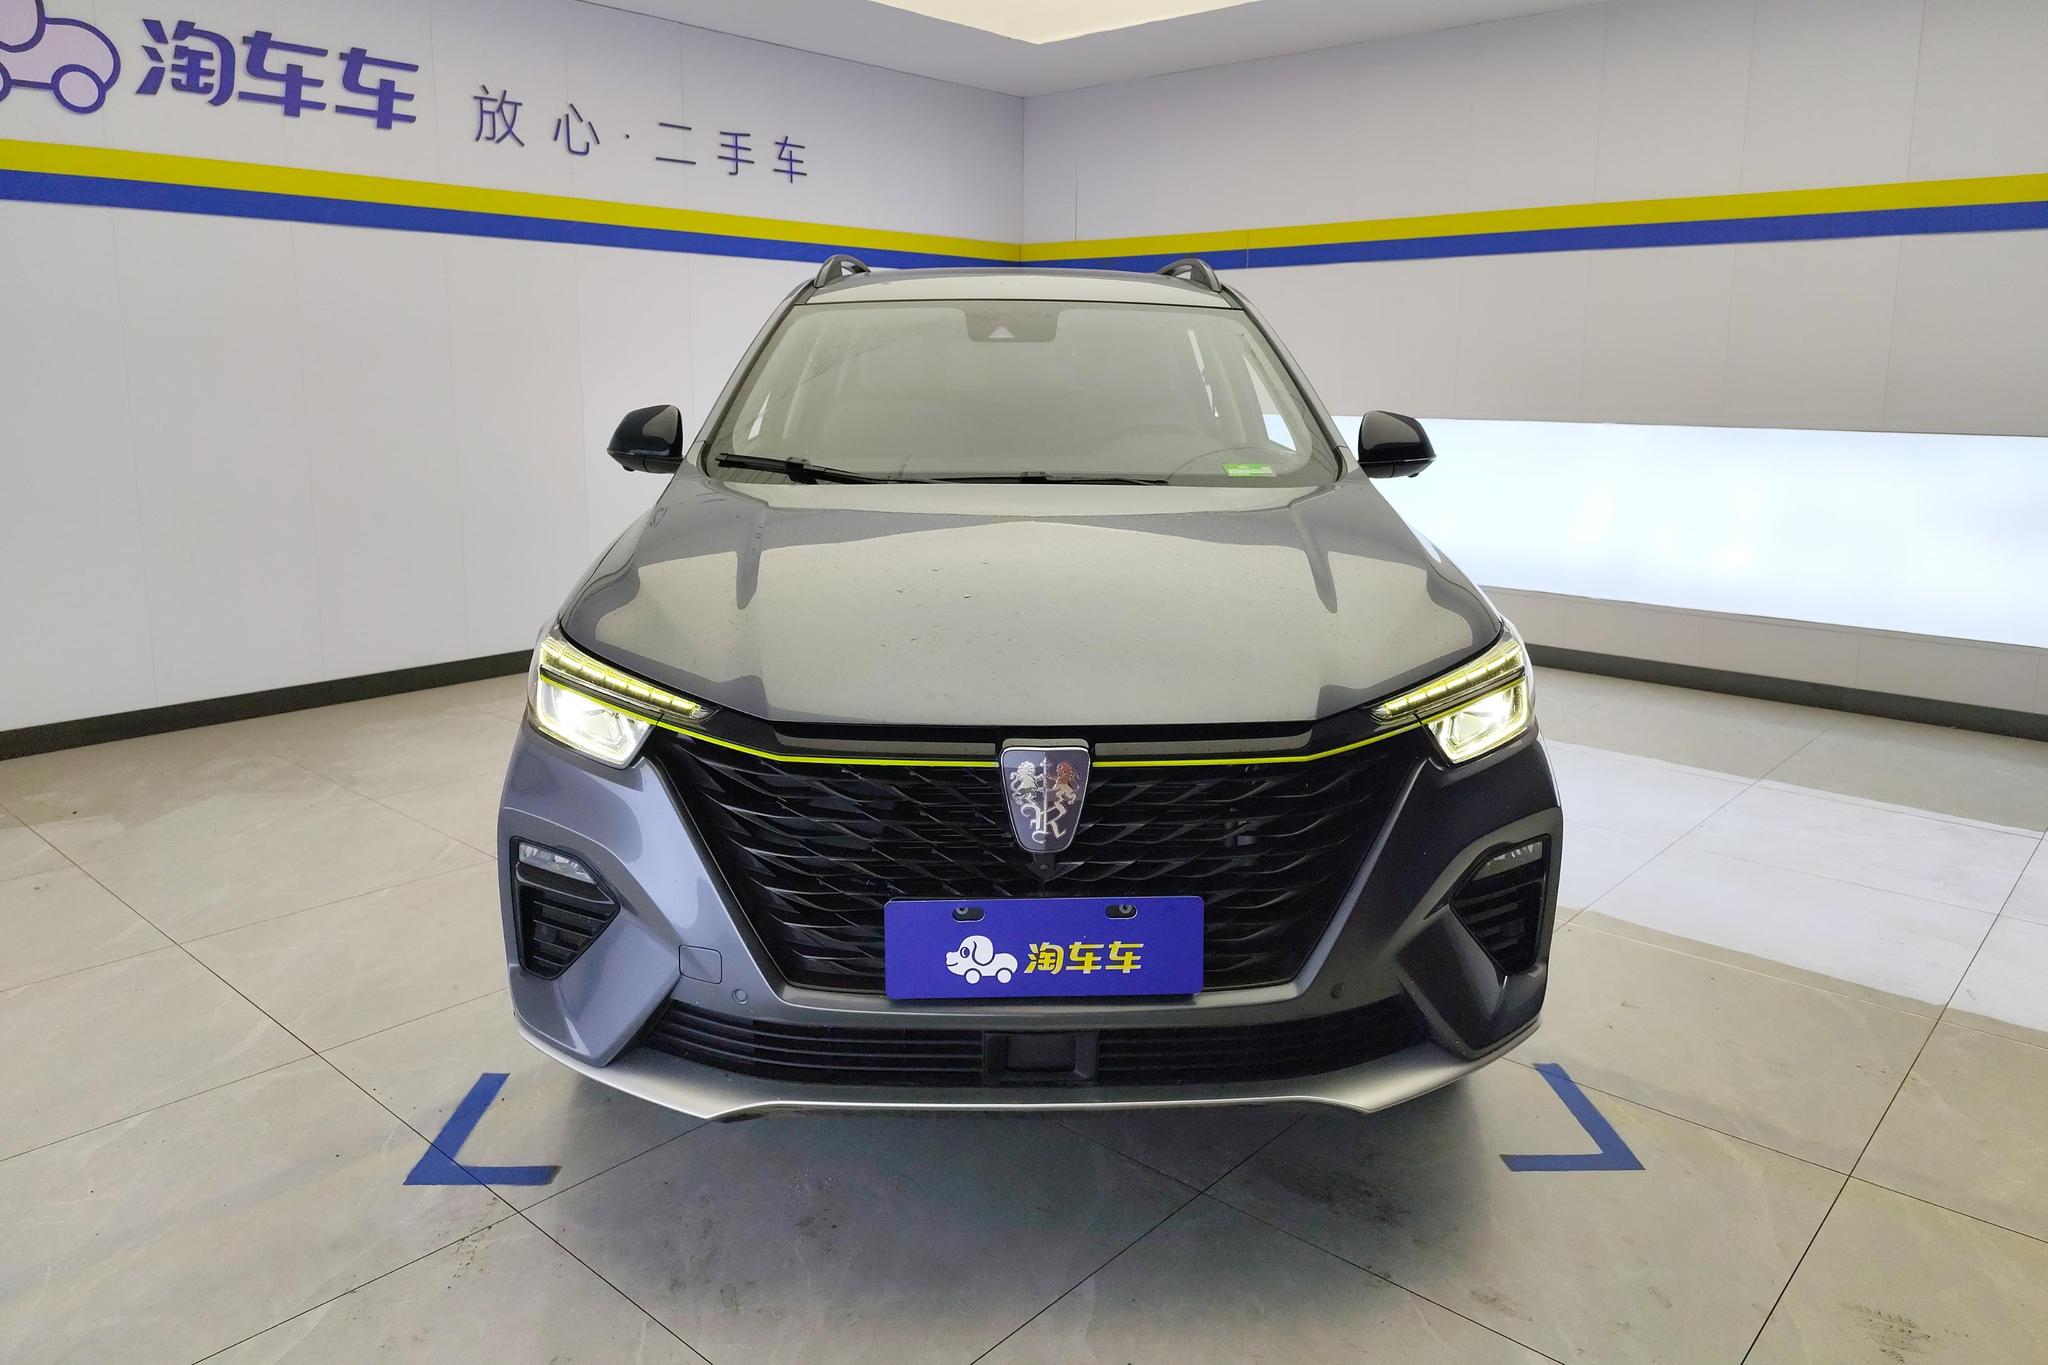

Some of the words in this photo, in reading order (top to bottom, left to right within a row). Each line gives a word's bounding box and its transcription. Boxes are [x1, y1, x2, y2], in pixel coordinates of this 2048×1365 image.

[136, 18, 420, 130] 淘车车
[1023, 940, 1145, 975] 淘车车
